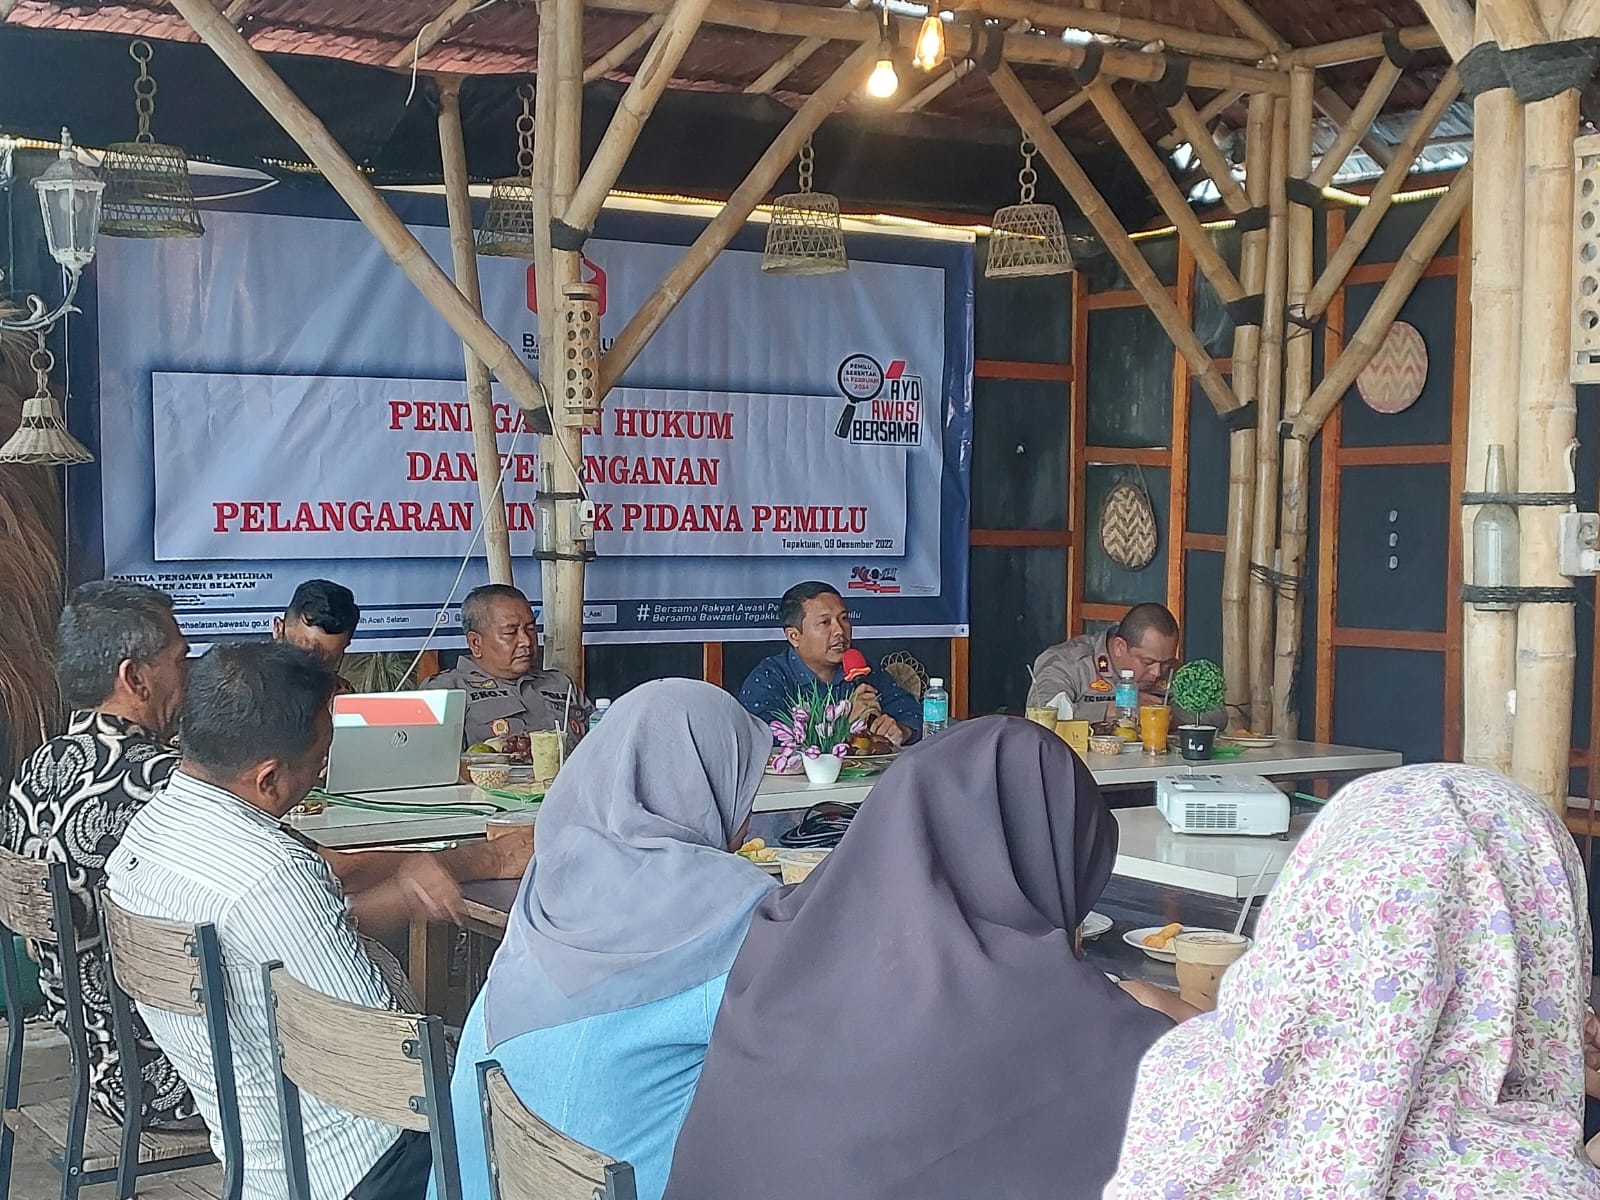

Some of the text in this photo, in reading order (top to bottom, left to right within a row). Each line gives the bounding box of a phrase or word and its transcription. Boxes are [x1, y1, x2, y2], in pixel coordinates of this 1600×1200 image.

[891, 380, 920, 401] AYO
[872, 400, 920, 422] AWASI
[614, 408, 734, 440] HUKUM
[853, 420, 920, 443] BERSAMA
[407, 451, 720, 486] DAN PENGANAN
[213, 500, 474, 532] PELANGARAN
[622, 503, 743, 532] PIDANA
[752, 505, 867, 534] PEMILU
[836, 539, 873, 550] Desember
[875, 540, 894, 549] 2022
[158, 573, 214, 581] PENGAWAS
[216, 572, 273, 580] PEMILIHAN
[178, 582, 206, 590] ACEH
[209, 581, 256, 589] SELATAN
[654, 605, 698, 613] Bersama
[701, 603, 735, 613] Rakyat
[737, 603, 765, 612] Awasi
[368, 615, 385, 624] Aceh
[386, 615, 410, 624] Selatan
[652, 613, 697, 622] Bersama
[699, 612, 741, 621] Bawaslu
